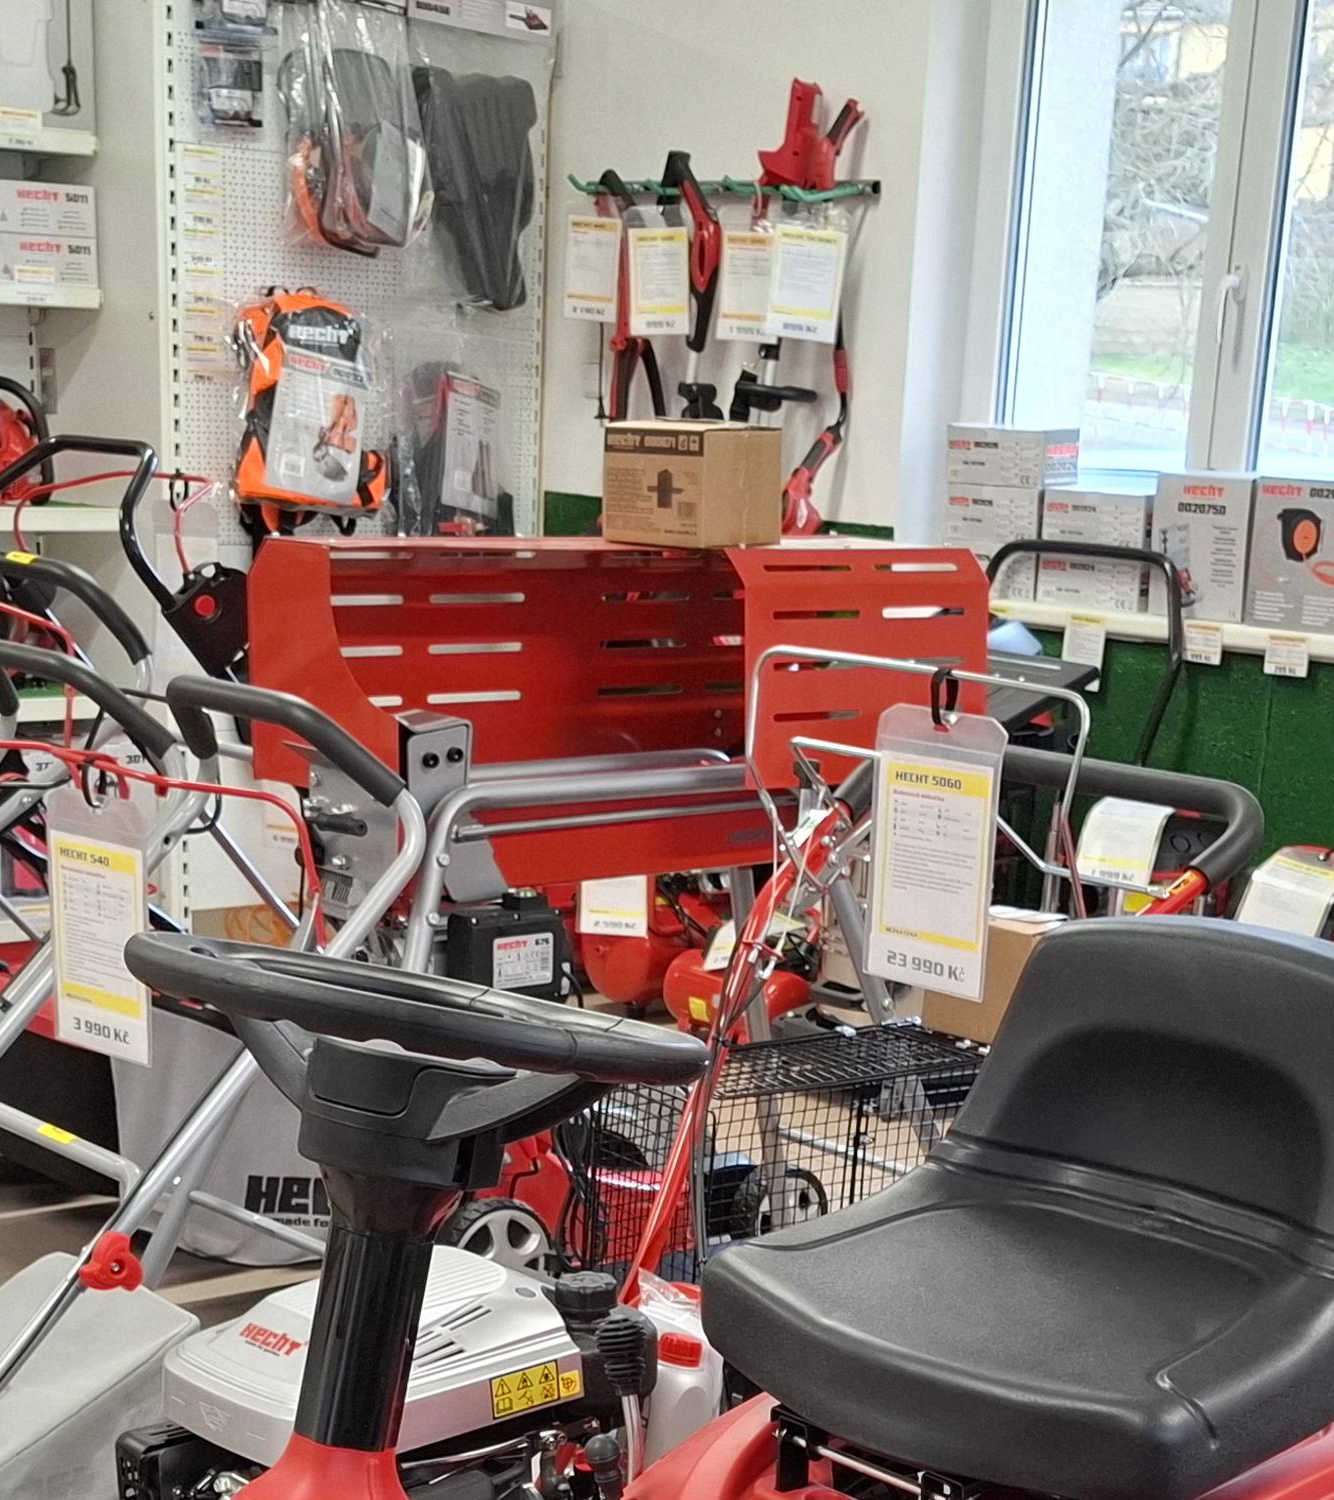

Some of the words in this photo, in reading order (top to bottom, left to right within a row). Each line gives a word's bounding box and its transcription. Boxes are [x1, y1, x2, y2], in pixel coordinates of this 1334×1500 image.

[895, 771, 930, 786] HECHT
[932, 775, 962, 791] 5060
[90, 853, 110, 867] 540
[887, 949, 908, 968] 23
[911, 955, 945, 978] 990
[73, 1017, 82, 1031] 3
[85, 1019, 111, 1039] 990
[113, 1027, 131, 1045] Kč
